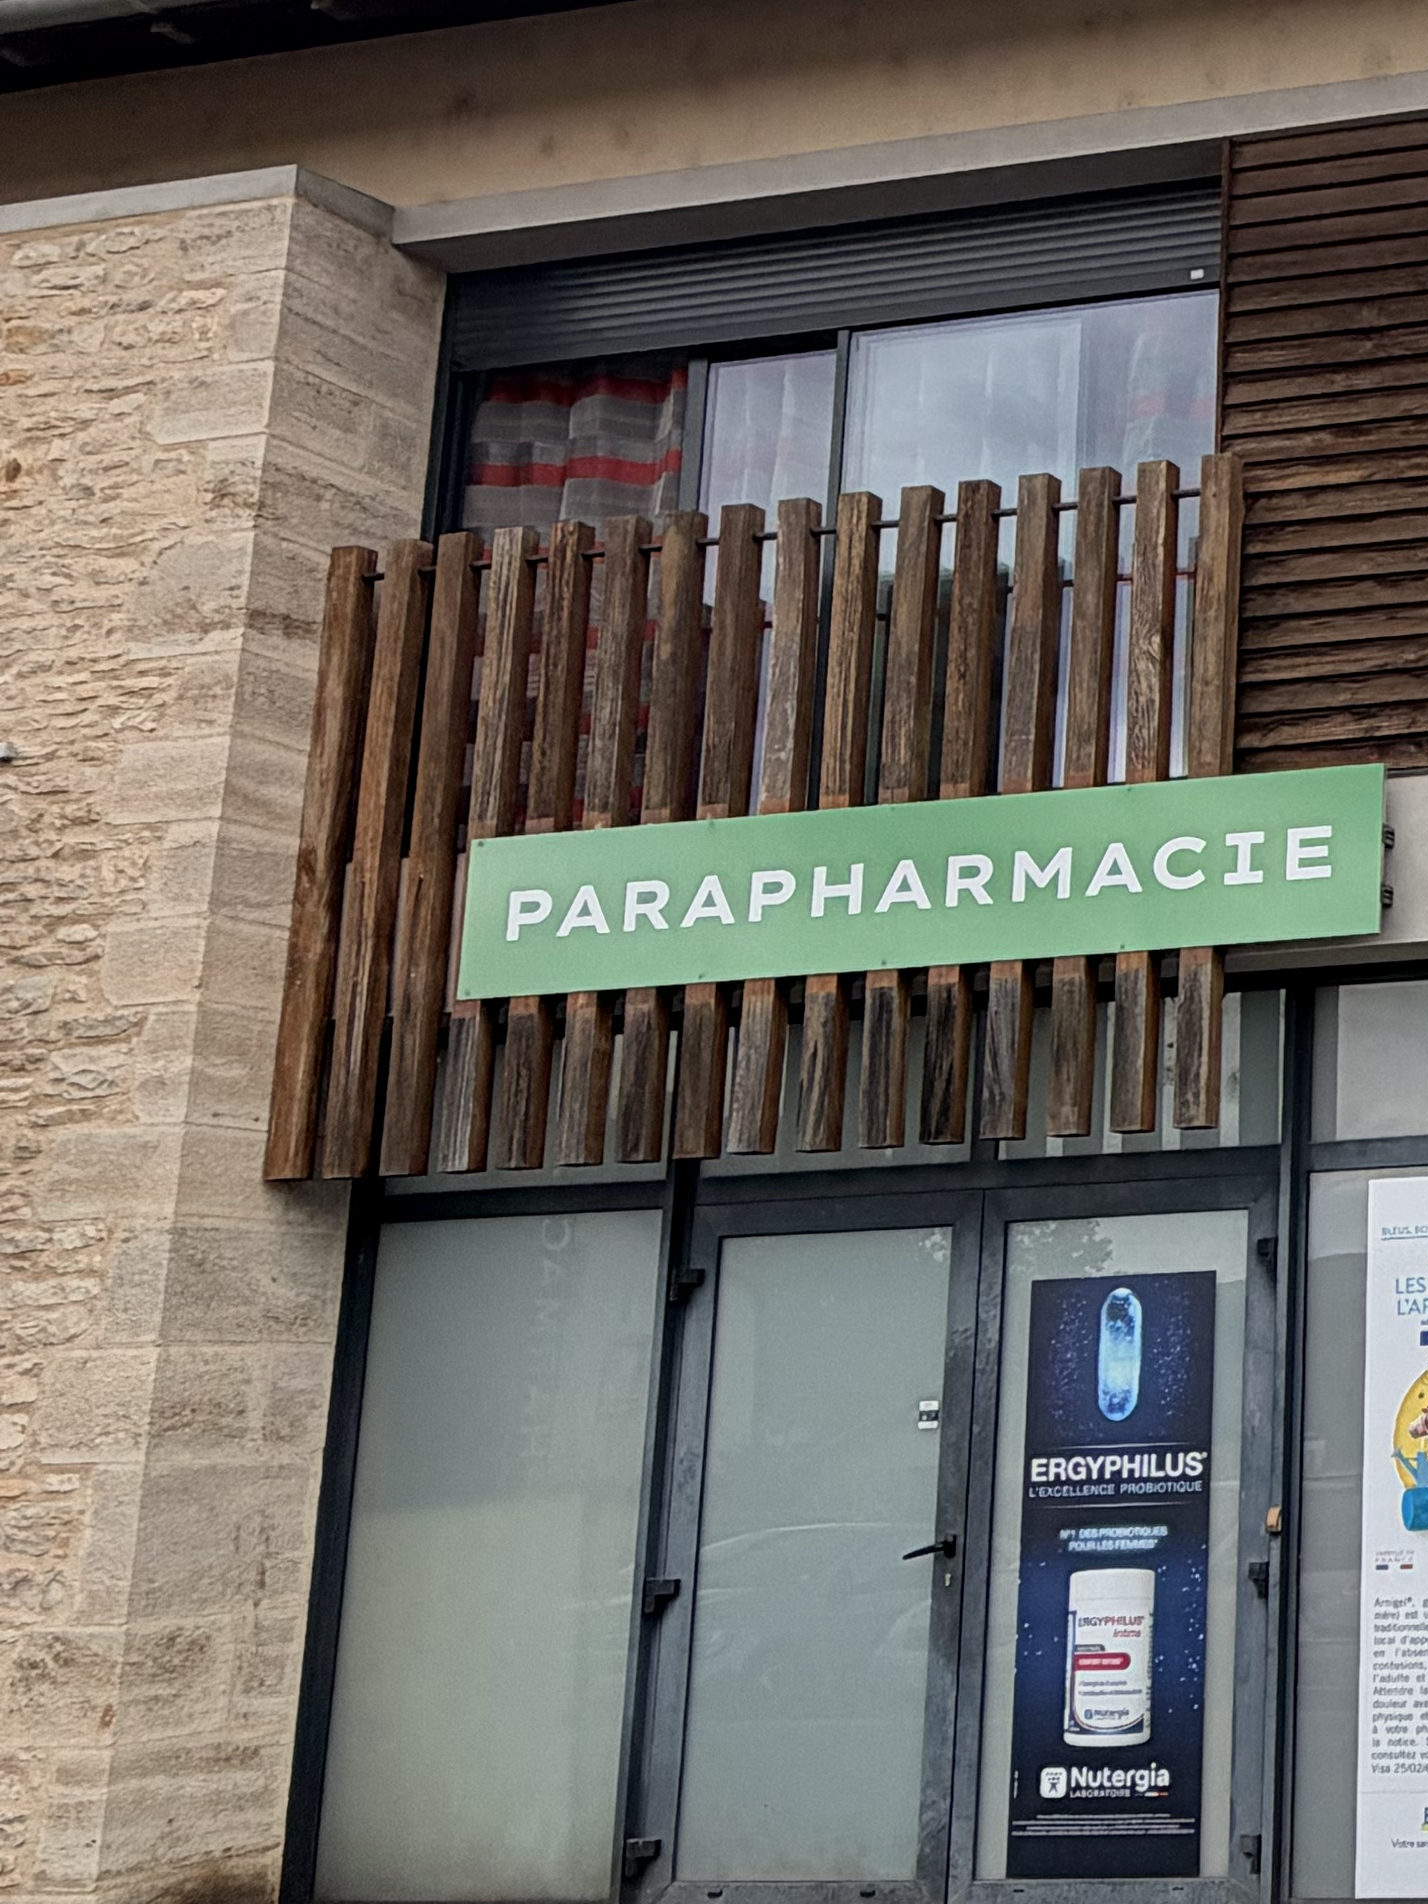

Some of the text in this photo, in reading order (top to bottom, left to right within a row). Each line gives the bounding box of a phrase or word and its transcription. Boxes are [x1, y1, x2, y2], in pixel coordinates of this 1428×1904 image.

[505, 824, 1334, 941] PARAPHARMACIE
[1395, 1277, 1426, 1294] LES
[1029, 1481, 1203, 1497] L'EXCELLENCE PROBIOTIQUE
[1071, 1762, 1170, 1792] Nutergia
